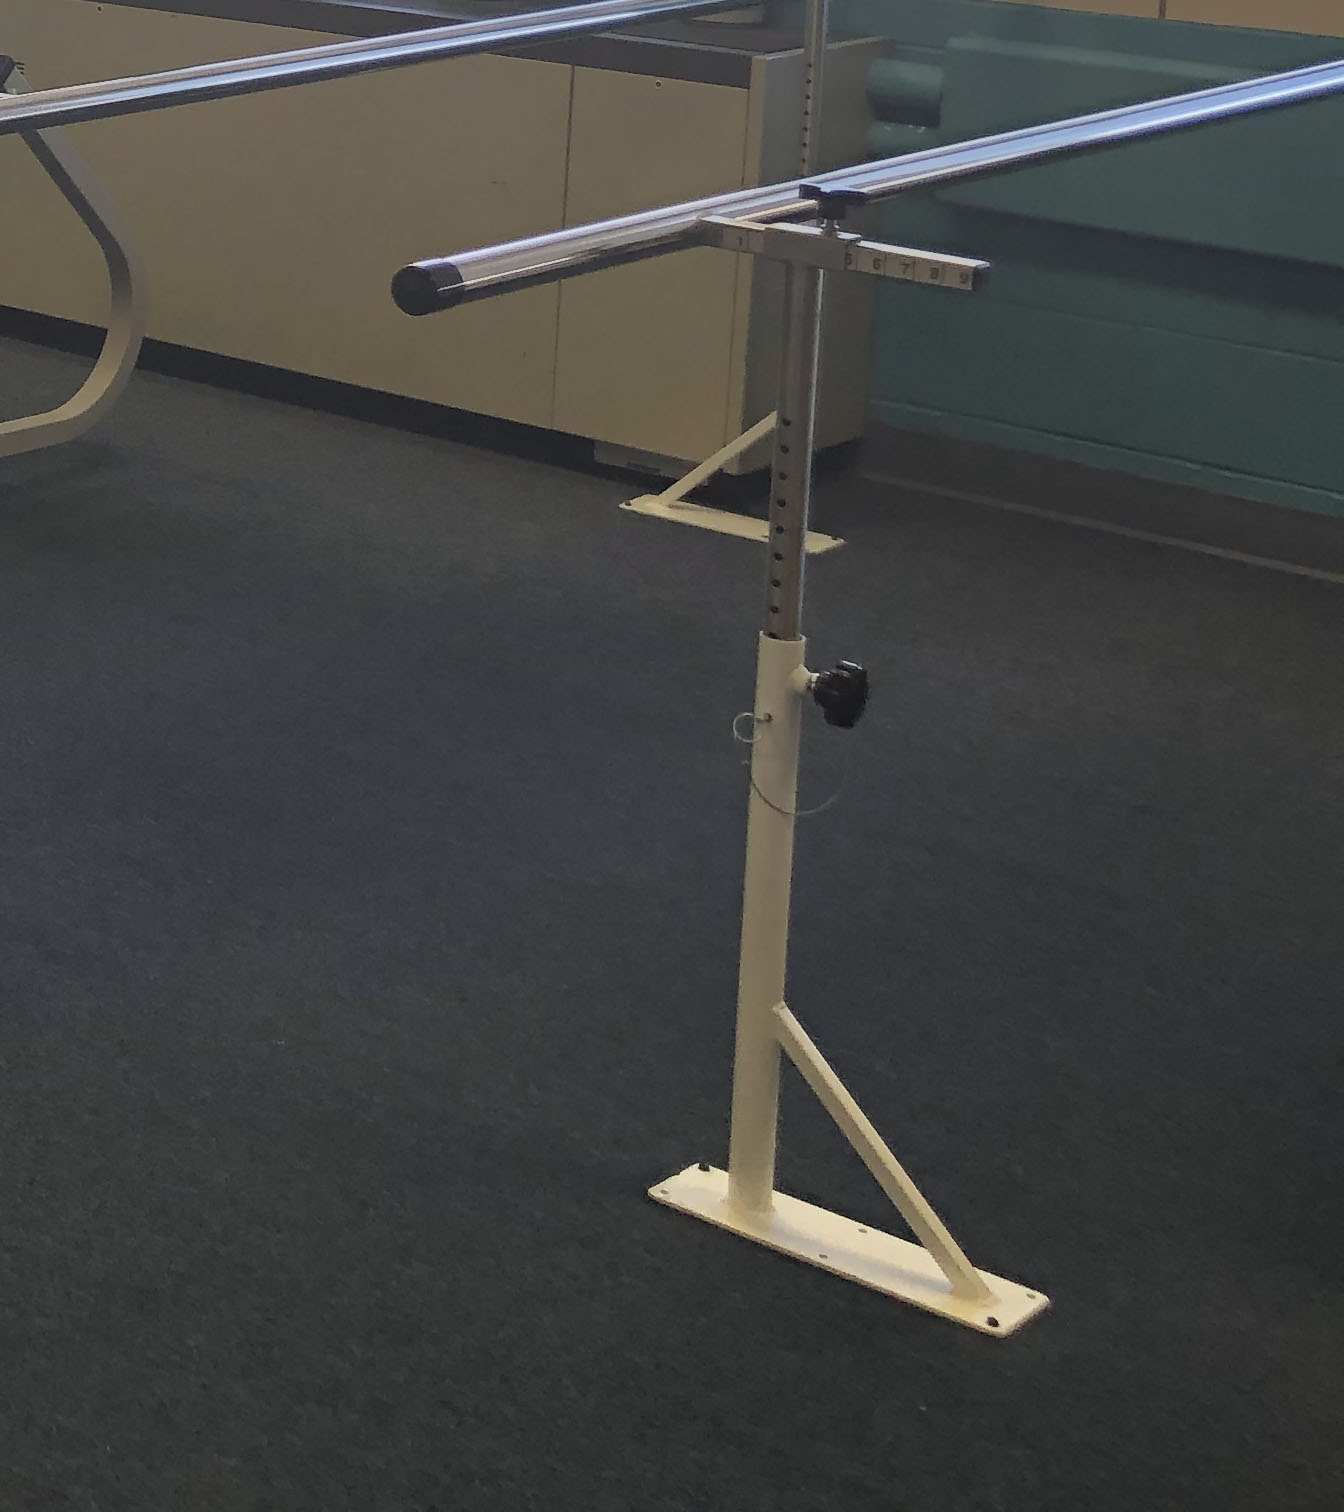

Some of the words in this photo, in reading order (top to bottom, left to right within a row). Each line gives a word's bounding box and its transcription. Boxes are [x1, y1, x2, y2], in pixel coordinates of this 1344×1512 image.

[872, 257, 881, 271] 6
[900, 263, 911, 275] 7
[930, 267, 939, 280] 8
